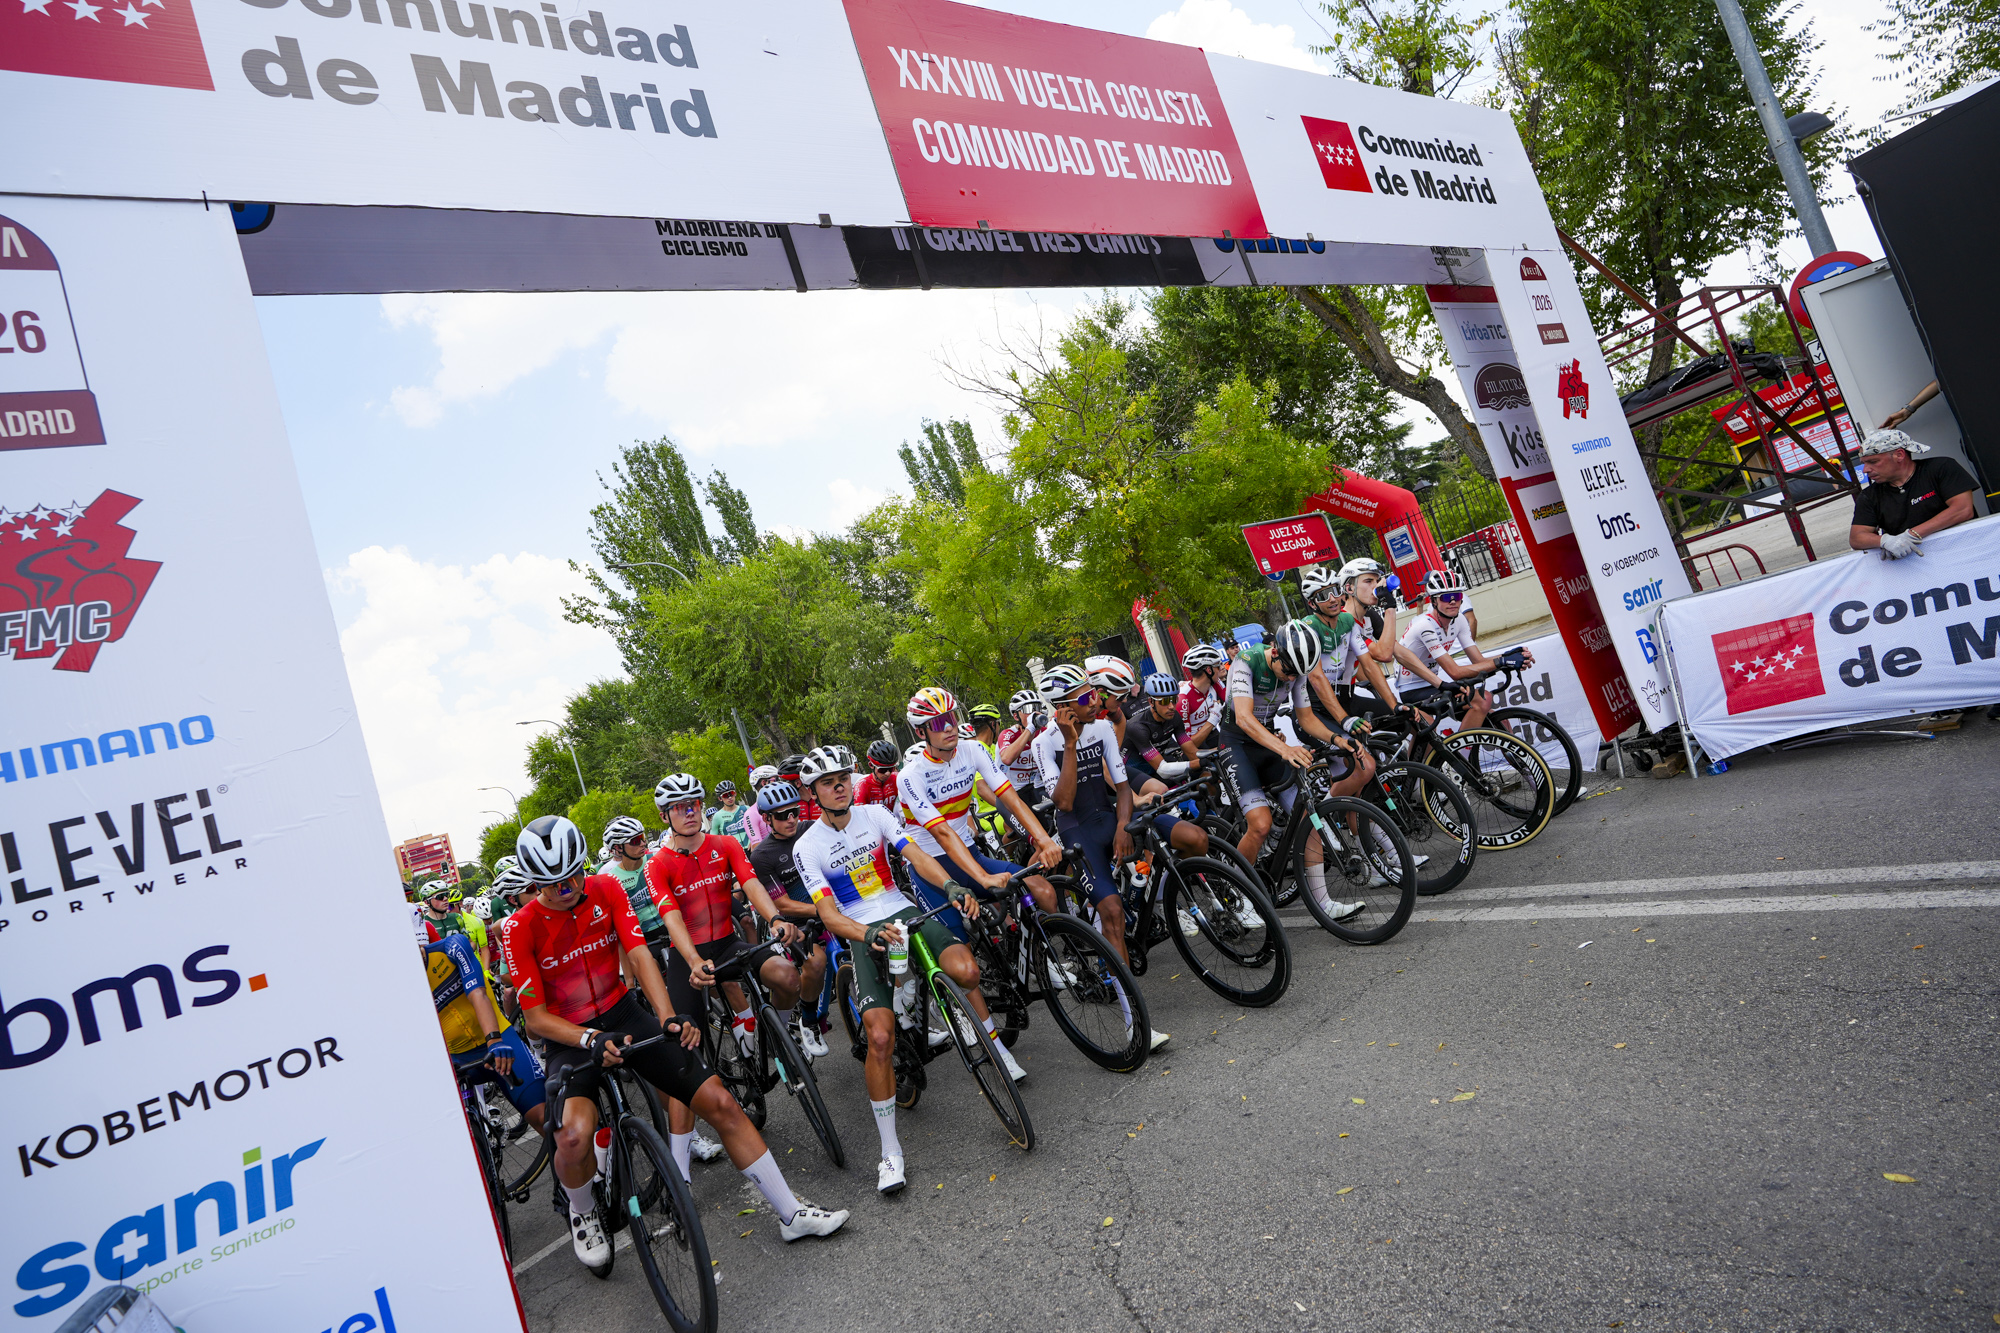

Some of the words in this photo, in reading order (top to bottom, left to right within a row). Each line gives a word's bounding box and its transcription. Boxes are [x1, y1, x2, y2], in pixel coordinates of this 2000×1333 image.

[234, 0, 698, 69] omunidad
[241, 36, 379, 105] de
[409, 53, 718, 139] Madrid
[888, 45, 1004, 103] XXXVIII
[1002, 64, 1101, 115] VUELTA
[1105, 81, 1212, 128] CICLISTA
[912, 117, 1095, 176] COMUNIDAD
[1094, 137, 1137, 180] DE
[1133, 143, 1233, 187] MADRID
[1357, 125, 1485, 169] Comunidad
[1375, 162, 1409, 198] de
[1412, 169, 1497, 205] Madrid
[661, 240, 748, 256] CICLISMO
[922, 229, 1024, 252] GRAVEL
[1028, 232, 1082, 253] TRES
[1532, 295, 1553, 311] 2026
[1568, 396, 1587, 411] FMC
[1572, 436, 1612, 454] SHIMANO
[1332, 488, 1378, 509] Comunidad
[1589, 485, 1628, 499] SPORTWEAR
[1329, 498, 1341, 507] de
[1343, 502, 1375, 518] Madrid
[1269, 525, 1292, 540] JUEZ
[1292, 524, 1306, 535] DE
[1597, 512, 1641, 540] bms.
[1271, 536, 1315, 554] LLEGADA
[1613, 547, 1660, 573] KOBEMOTOR
[1566, 574, 1593, 597] MAD
[1623, 577, 1663, 611] sanir
[1839, 644, 1923, 688] de
[1464, 734, 1528, 757] LIMITED
[904, 778, 919, 801] CORTIZO
[941, 773, 974, 794] CORTIZO
[0, 788, 243, 905] LEVEL
[830, 854, 852, 869] CAJA
[852, 841, 880, 858] RURAL
[844, 853, 876, 875] ALEA
[503, 919, 519, 977] smartlog
[562, 930, 618, 964] smartlog
[456, 952, 470, 974] CORTIZO
[18, 1037, 344, 1178] KOBEMOTOR
[14, 1136, 328, 1318] sanir
[210, 1217, 295, 1263] Sanitario
